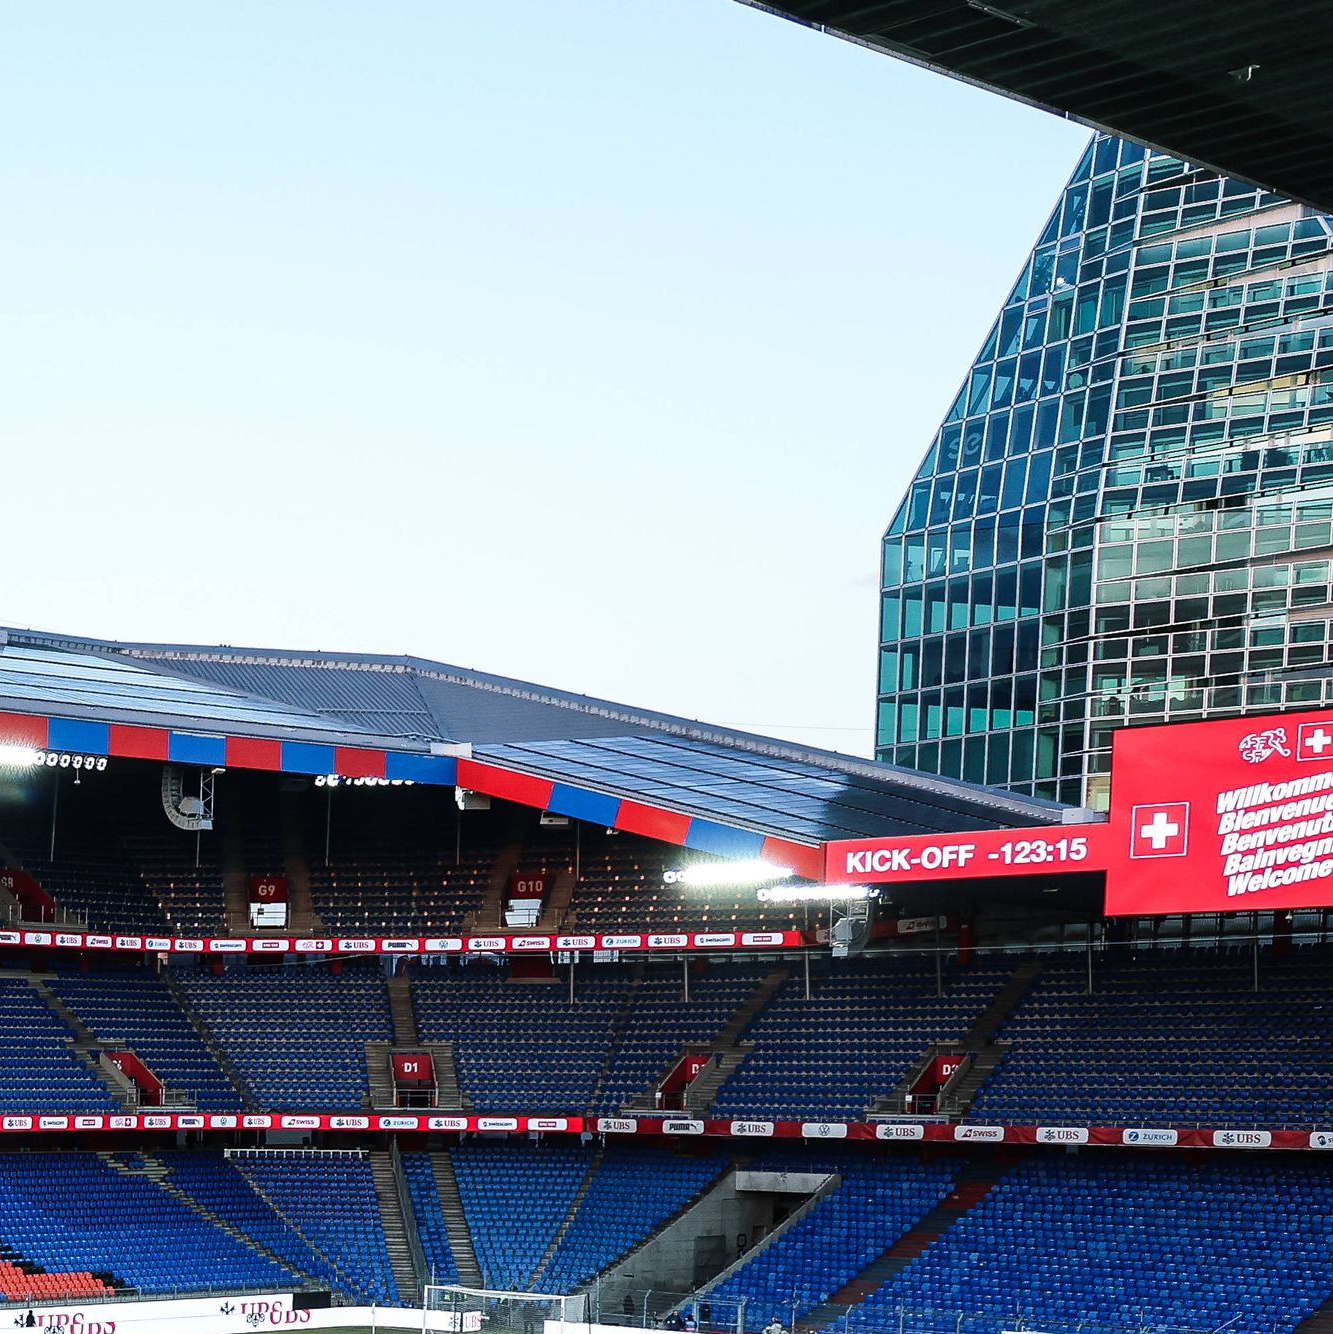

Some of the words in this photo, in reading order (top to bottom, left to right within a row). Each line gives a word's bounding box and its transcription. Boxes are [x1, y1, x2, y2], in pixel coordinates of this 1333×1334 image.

[846, 844, 976, 874] KICK-OFF
[988, 837, 1087, 865] -123:15
[1227, 858, 1333, 897] Welcome
[258, 885, 275, 897] G9
[517, 881, 542, 892] G10
[404, 1062, 418, 1073] D1
[747, 1124, 767, 1133] UBS
[895, 1128, 916, 1136] UBS
[1057, 1131, 1079, 1139] UBS
[1236, 1134, 1261, 1143] UBS
